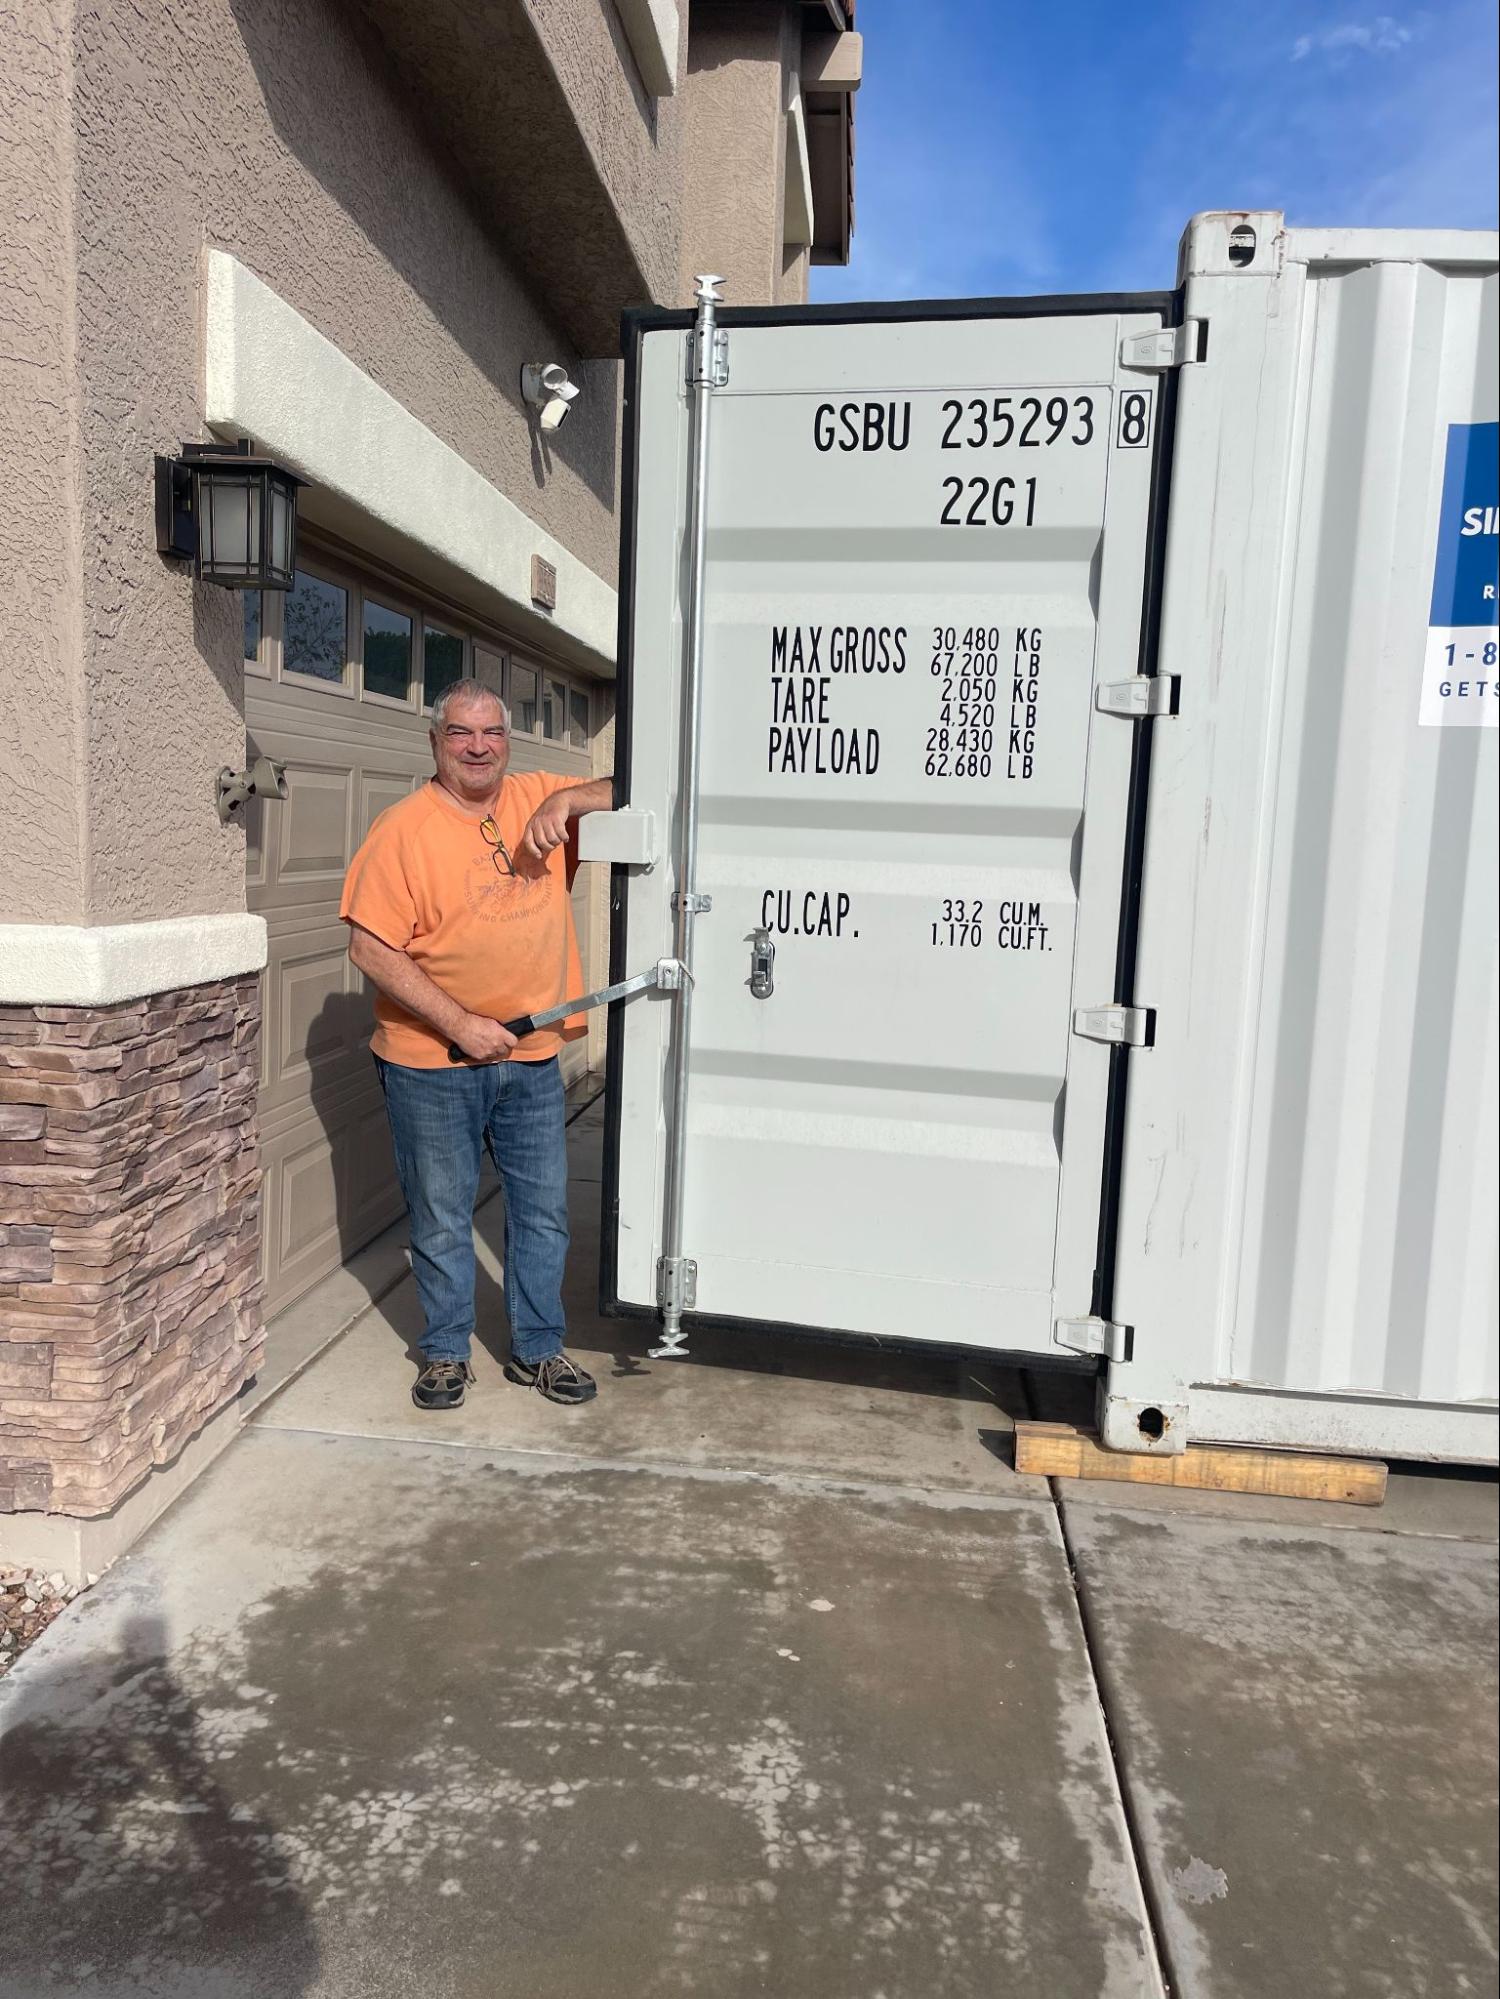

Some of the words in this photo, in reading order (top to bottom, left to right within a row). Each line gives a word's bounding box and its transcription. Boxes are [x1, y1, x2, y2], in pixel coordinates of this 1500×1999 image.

[814, 402, 911, 451] GSBU
[941, 396, 1094, 449] 235293
[1122, 394, 1146, 445] 8
[940, 476, 1037, 526] 22G1
[1483, 585, 1499, 600] R
[771, 627, 822, 673] MAX
[831, 627, 907, 673] GROSS
[1016, 628, 1042, 652] KG
[1014, 653, 1040, 677] LB
[771, 677, 831, 723] TARE
[1013, 679, 1039, 703] KG
[1011, 705, 1037, 728] LB
[769, 727, 880, 774] PAYLOAD
[1009, 730, 1035, 753] KG
[1008, 755, 1033, 778] LB
[761, 890, 859, 937] CU.CAP.
[942, 899, 983, 923] 33.2
[1000, 902, 1044, 926] CU.M.
[998, 926, 1052, 951] CU.FT.
